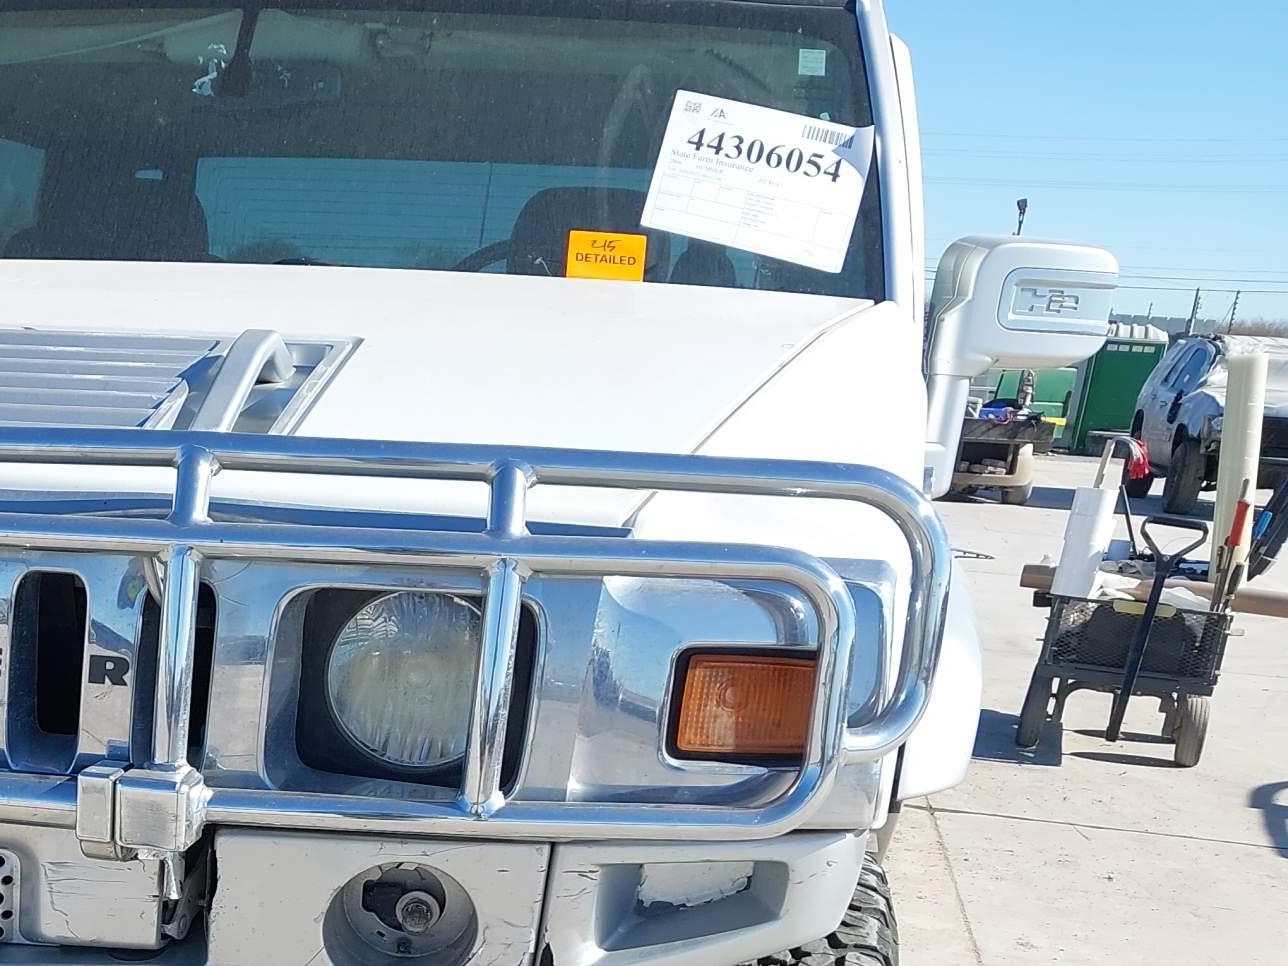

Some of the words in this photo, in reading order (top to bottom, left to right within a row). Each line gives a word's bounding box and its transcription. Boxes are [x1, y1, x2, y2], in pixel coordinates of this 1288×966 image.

[671, 148, 691, 159] State
[693, 152, 713, 164] Farm
[715, 157, 754, 173] Insurance
[687, 127, 843, 183] 44306054
[575, 252, 637, 266] DETAILED
